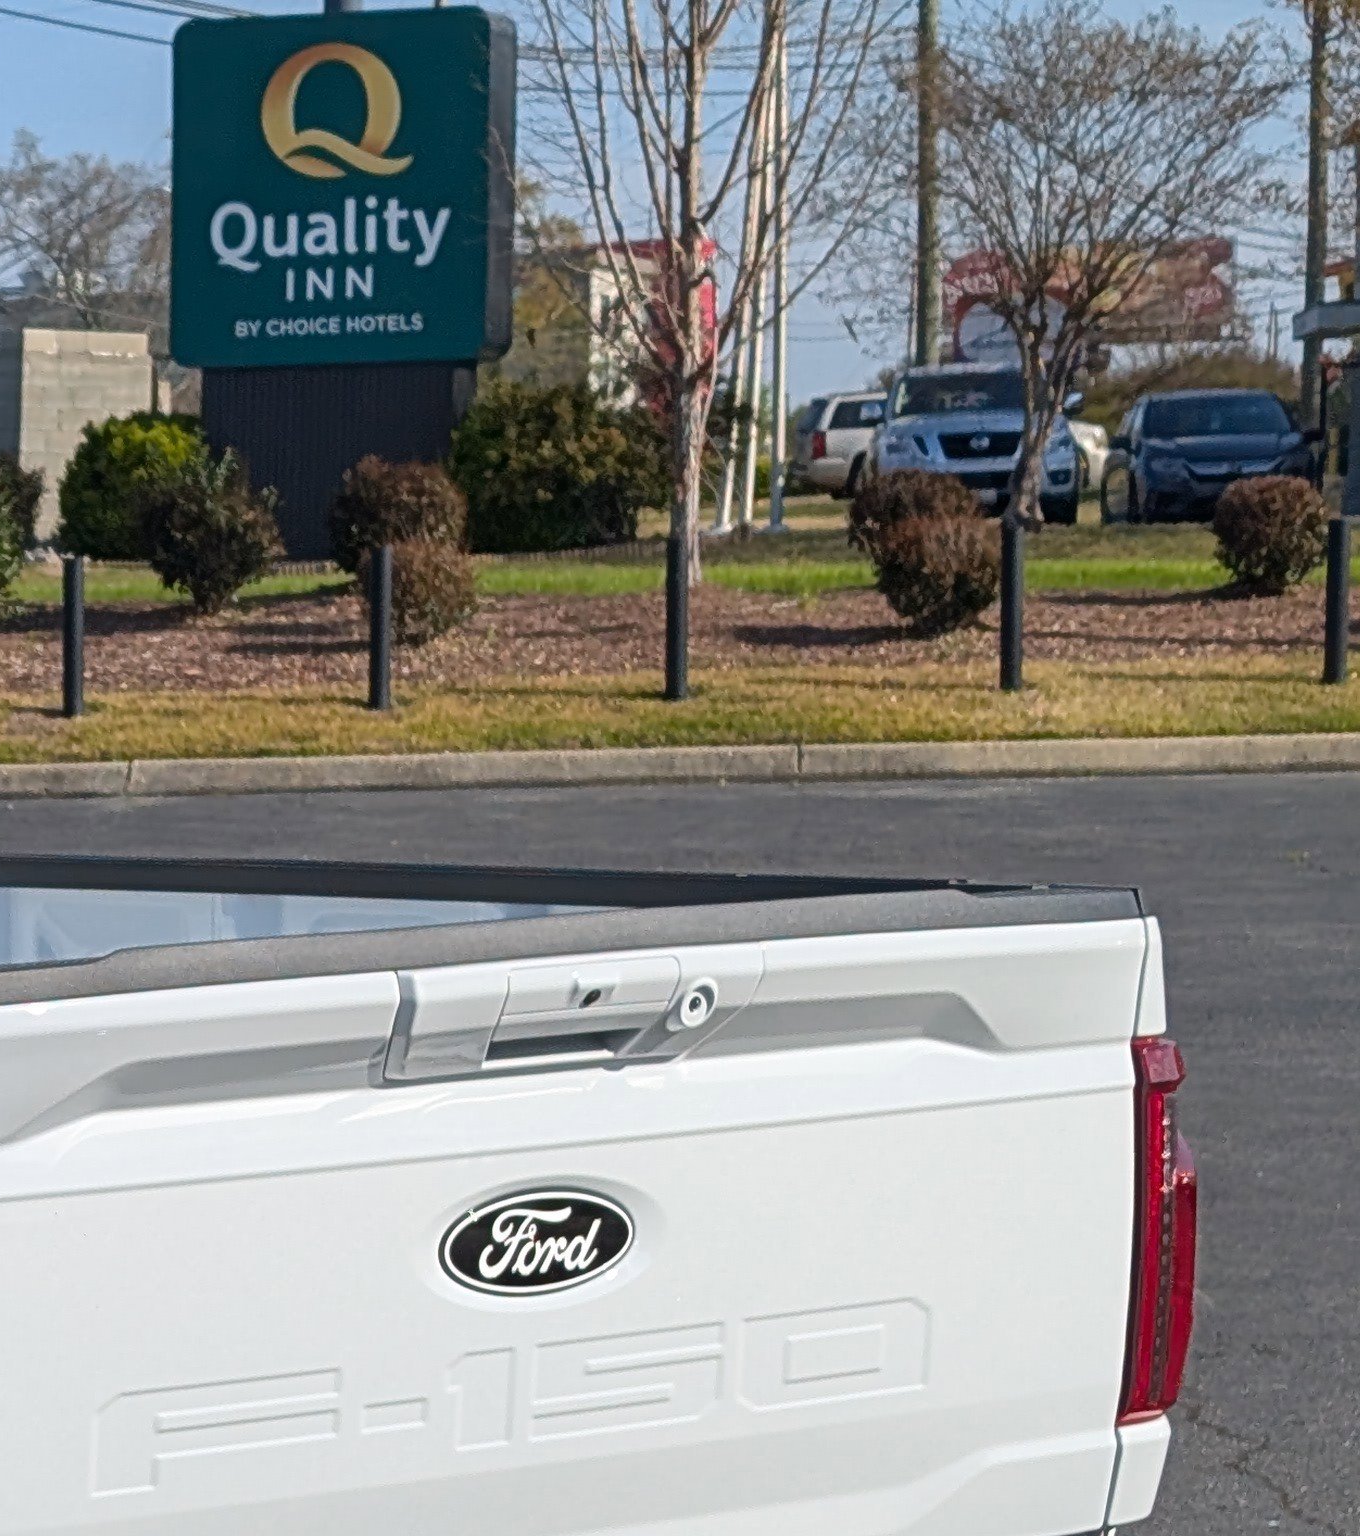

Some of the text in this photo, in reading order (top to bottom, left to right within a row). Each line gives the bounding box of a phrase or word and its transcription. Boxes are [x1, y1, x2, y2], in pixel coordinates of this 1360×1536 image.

[261, 42, 414, 178] Q
[210, 195, 451, 272] Quality
[285, 264, 374, 301] INN
[234, 312, 424, 338] BY CHOICE HOTELS
[479, 1206, 602, 1279] Ford
[90, 1297, 933, 1498] F-150
